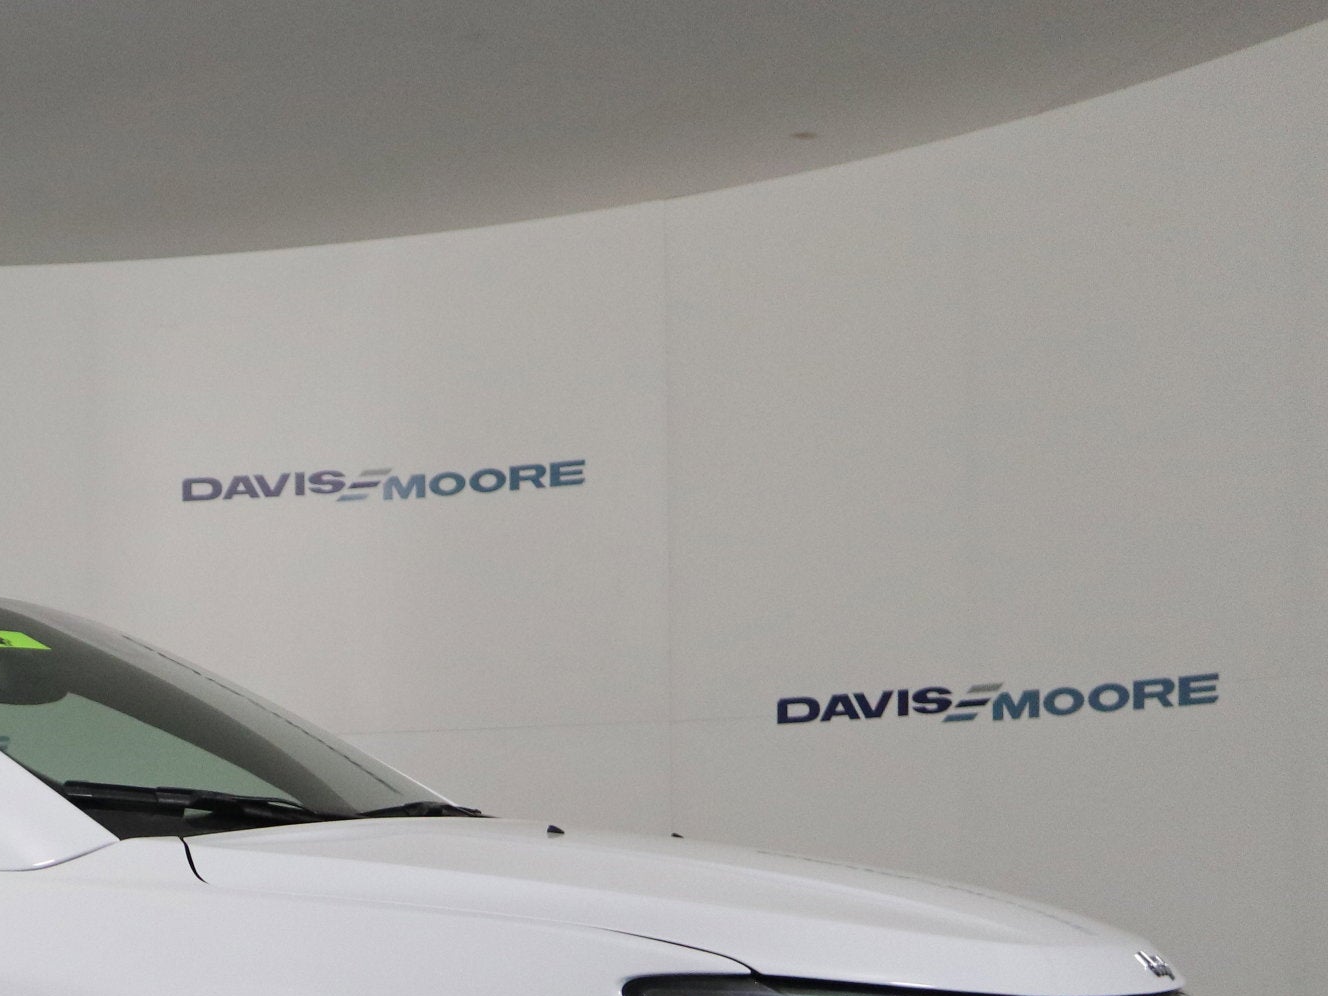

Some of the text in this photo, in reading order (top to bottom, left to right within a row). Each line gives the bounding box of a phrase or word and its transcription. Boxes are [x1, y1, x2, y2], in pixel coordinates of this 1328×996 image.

[181, 459, 586, 501] DAVIS MOORE
[776, 672, 1220, 724] DAVIS MOORE
